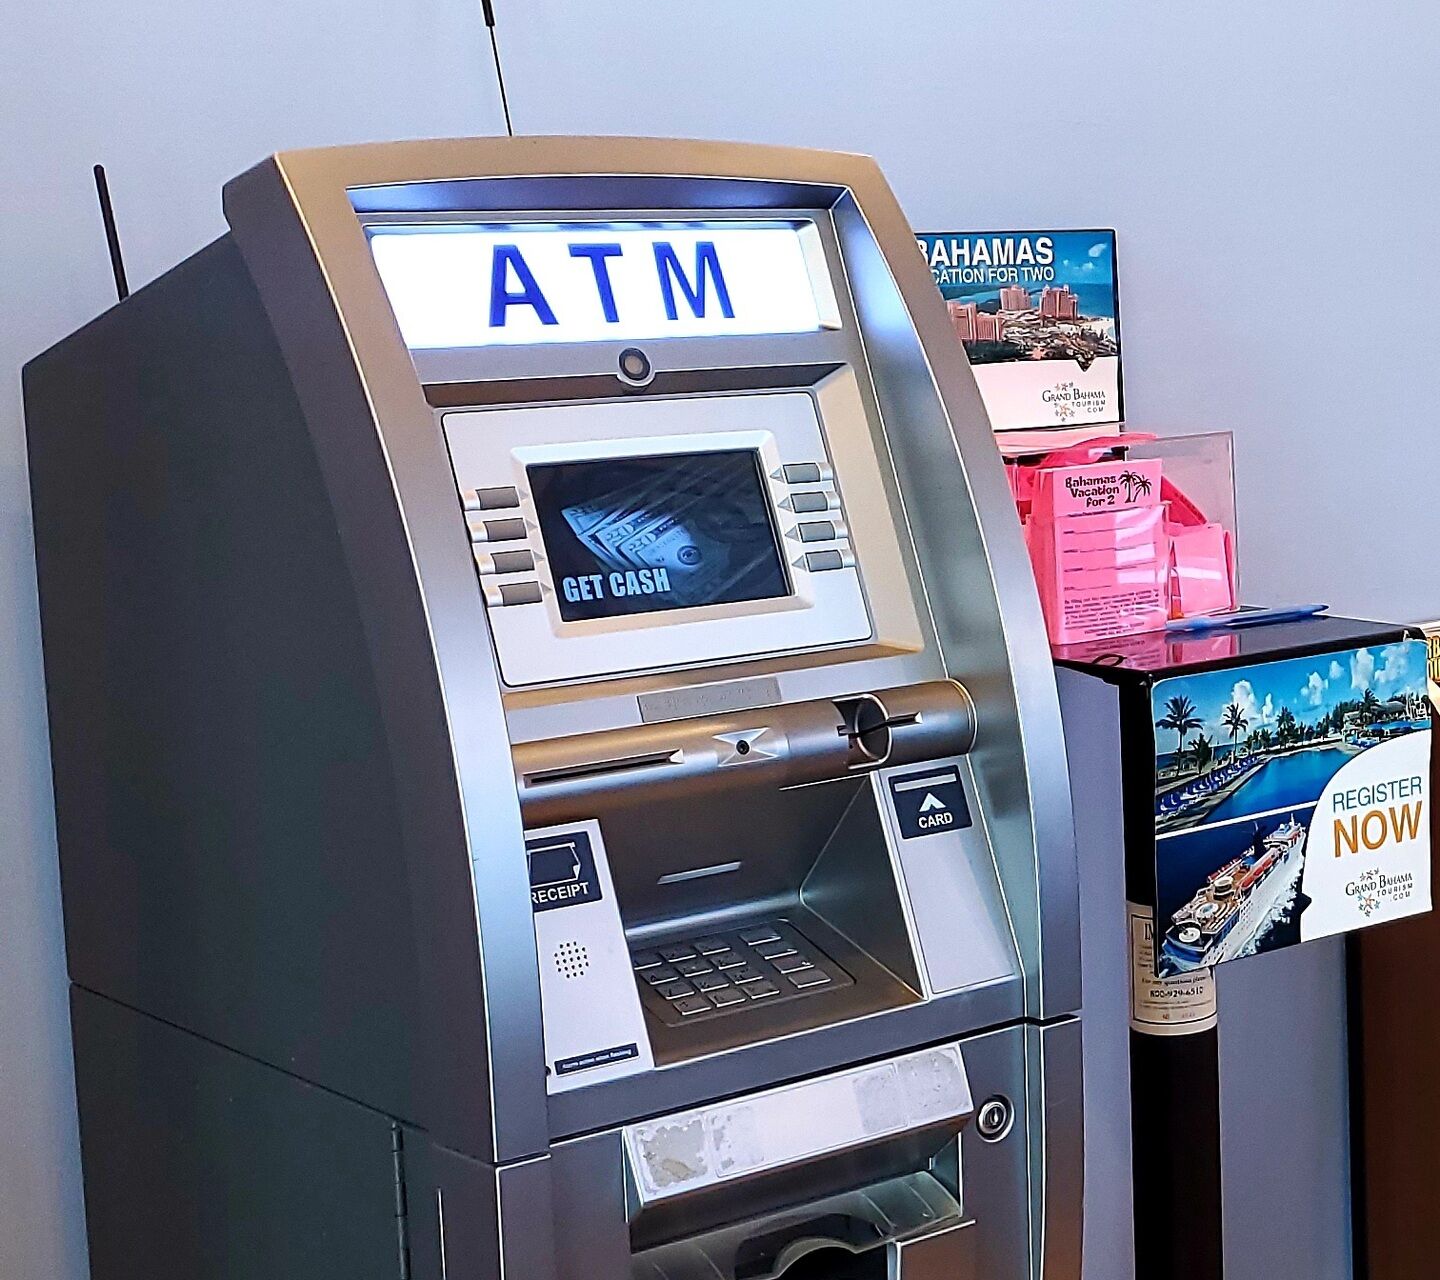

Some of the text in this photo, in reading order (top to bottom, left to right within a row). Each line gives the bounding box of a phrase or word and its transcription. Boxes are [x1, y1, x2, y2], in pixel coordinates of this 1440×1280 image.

[488, 240, 736, 328] ATM
[933, 267, 1055, 284] CATION FOR TWO
[1042, 389, 1106, 402] GRAND BAHAMA
[1065, 476, 1117, 488] Bahamas
[1070, 486, 1120, 498] Vacation
[1086, 495, 1115, 508] for 2
[563, 567, 671, 603] GET CASH
[1333, 776, 1422, 814] REGISTER
[917, 810, 955, 830] CARD
[1334, 800, 1423, 858] NOW
[531, 882, 589, 904] RECEIPT
[1345, 873, 1412, 896] GRAND BAHAMA
